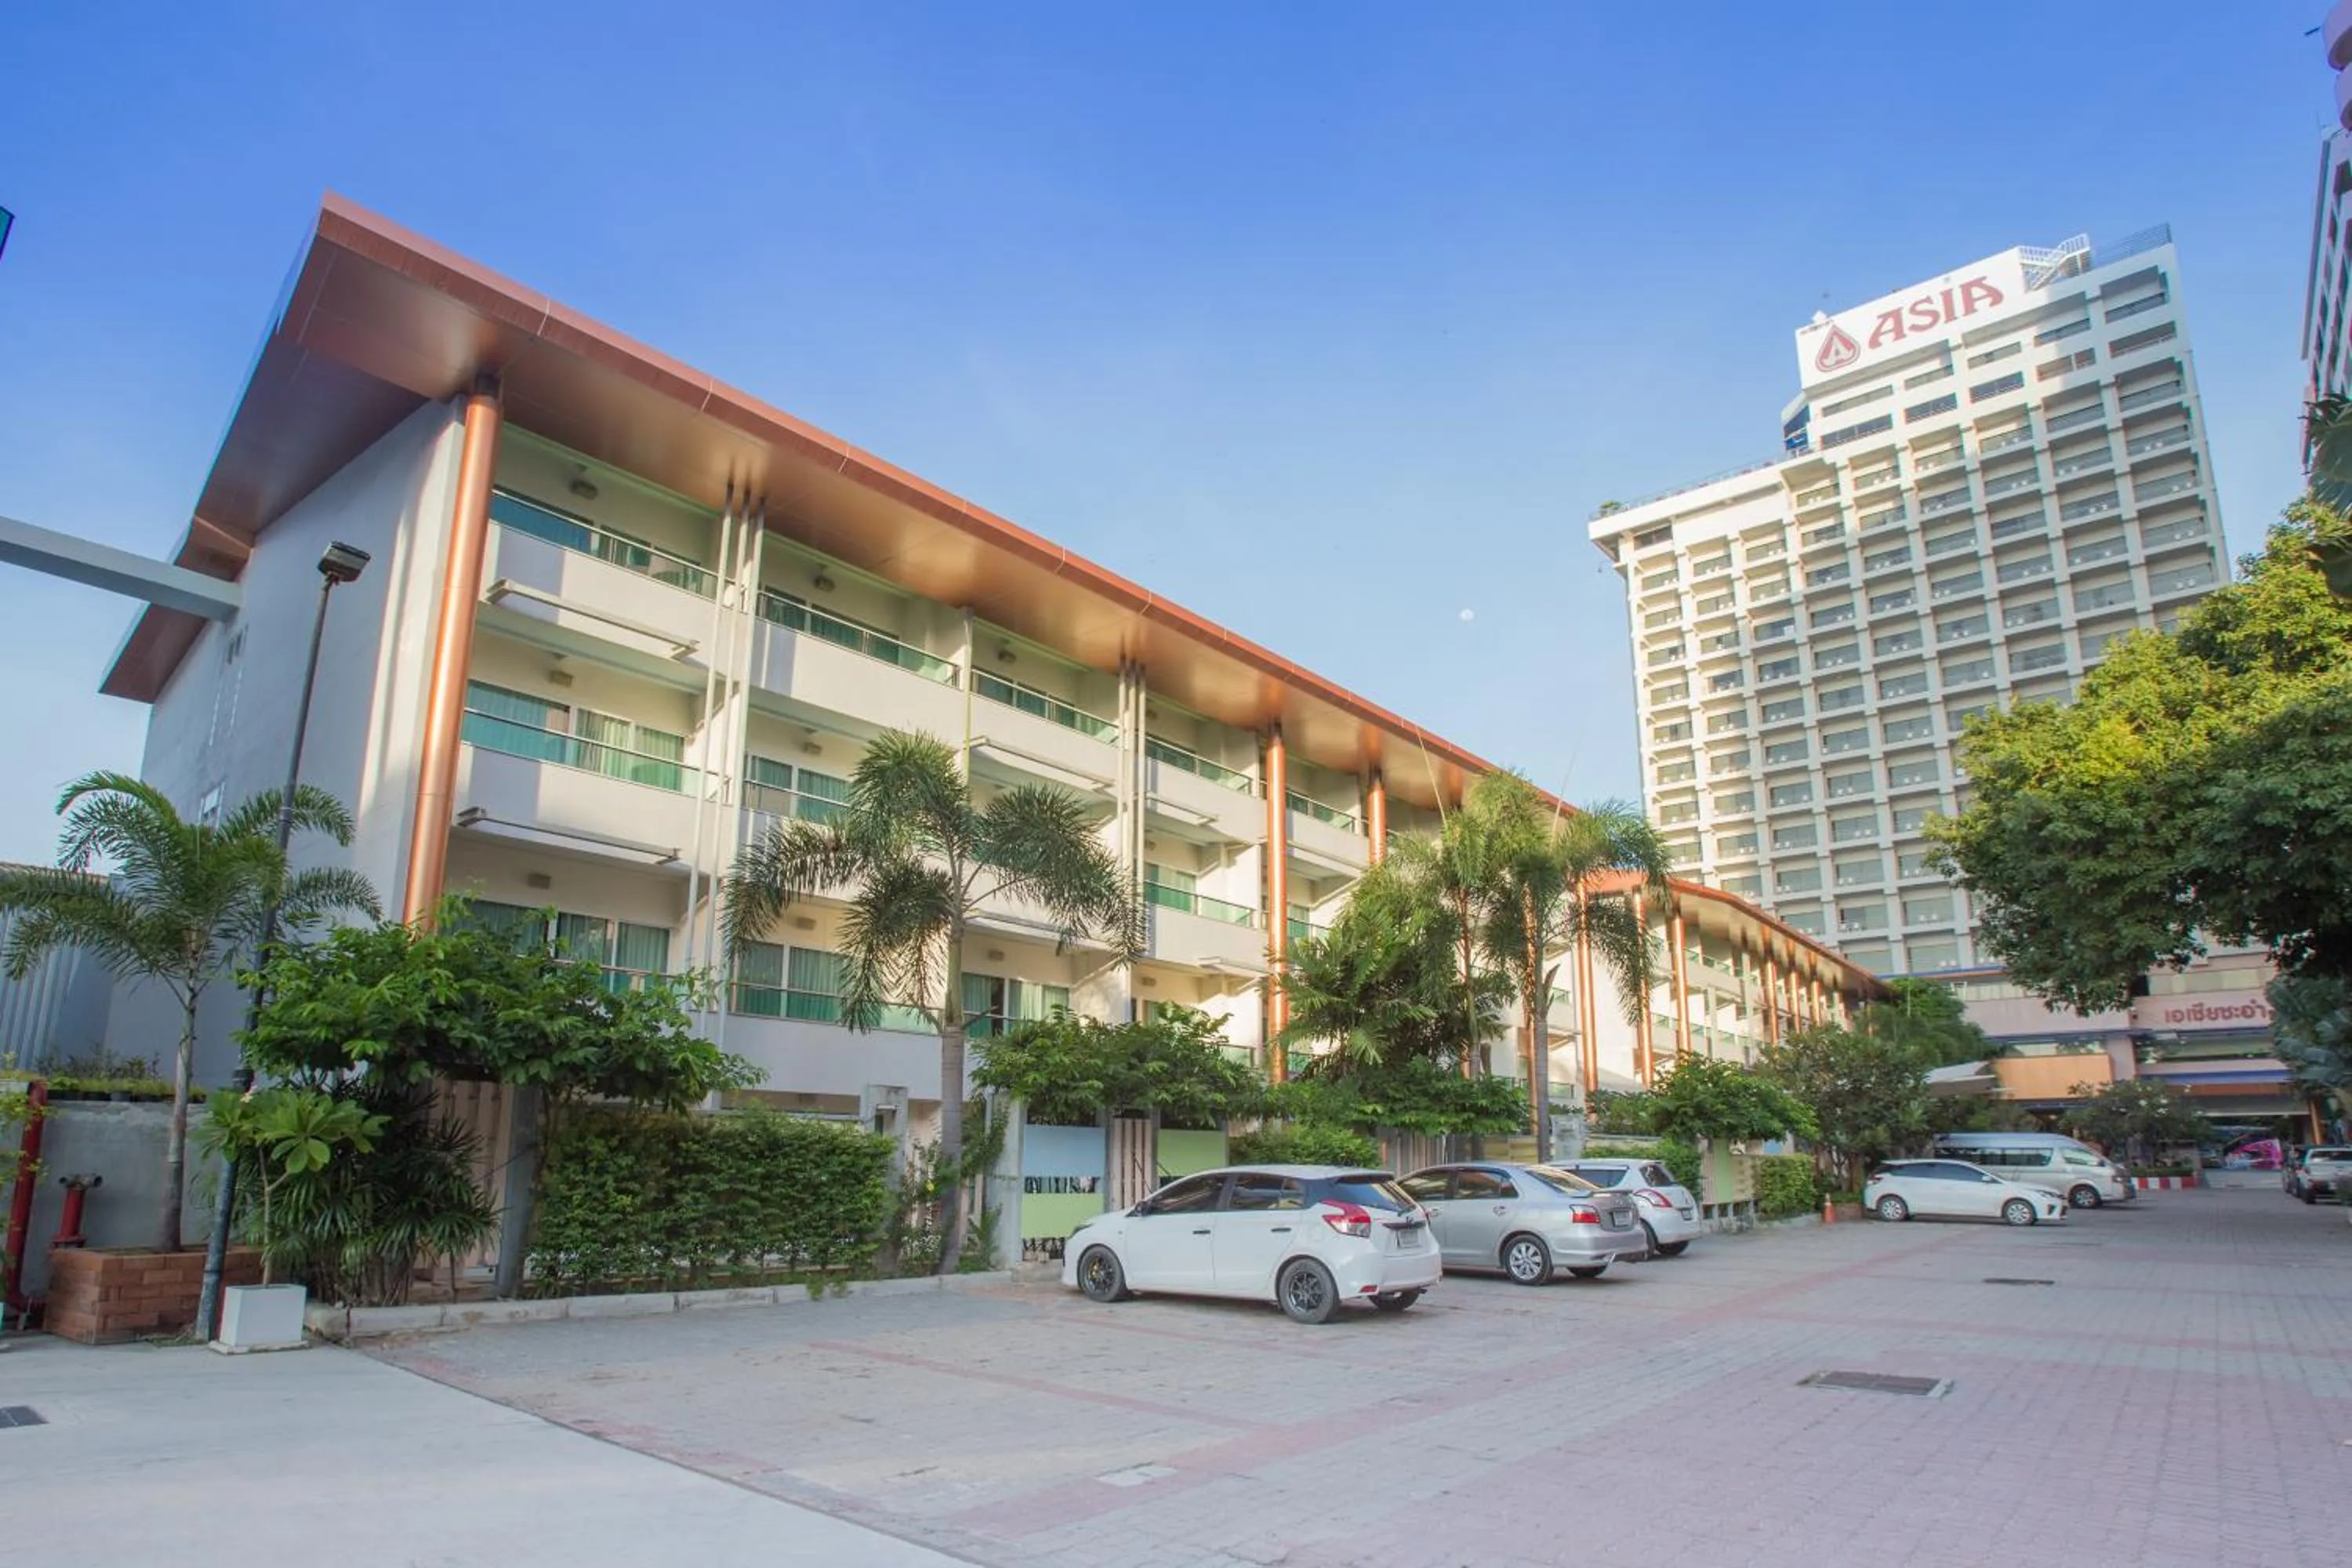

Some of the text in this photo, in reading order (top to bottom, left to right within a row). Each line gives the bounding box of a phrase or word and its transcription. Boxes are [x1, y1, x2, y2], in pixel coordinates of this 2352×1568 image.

[1868, 276, 2004, 350] ASIA
[2164, 998, 2274, 1023] เอเชียชะอำ
